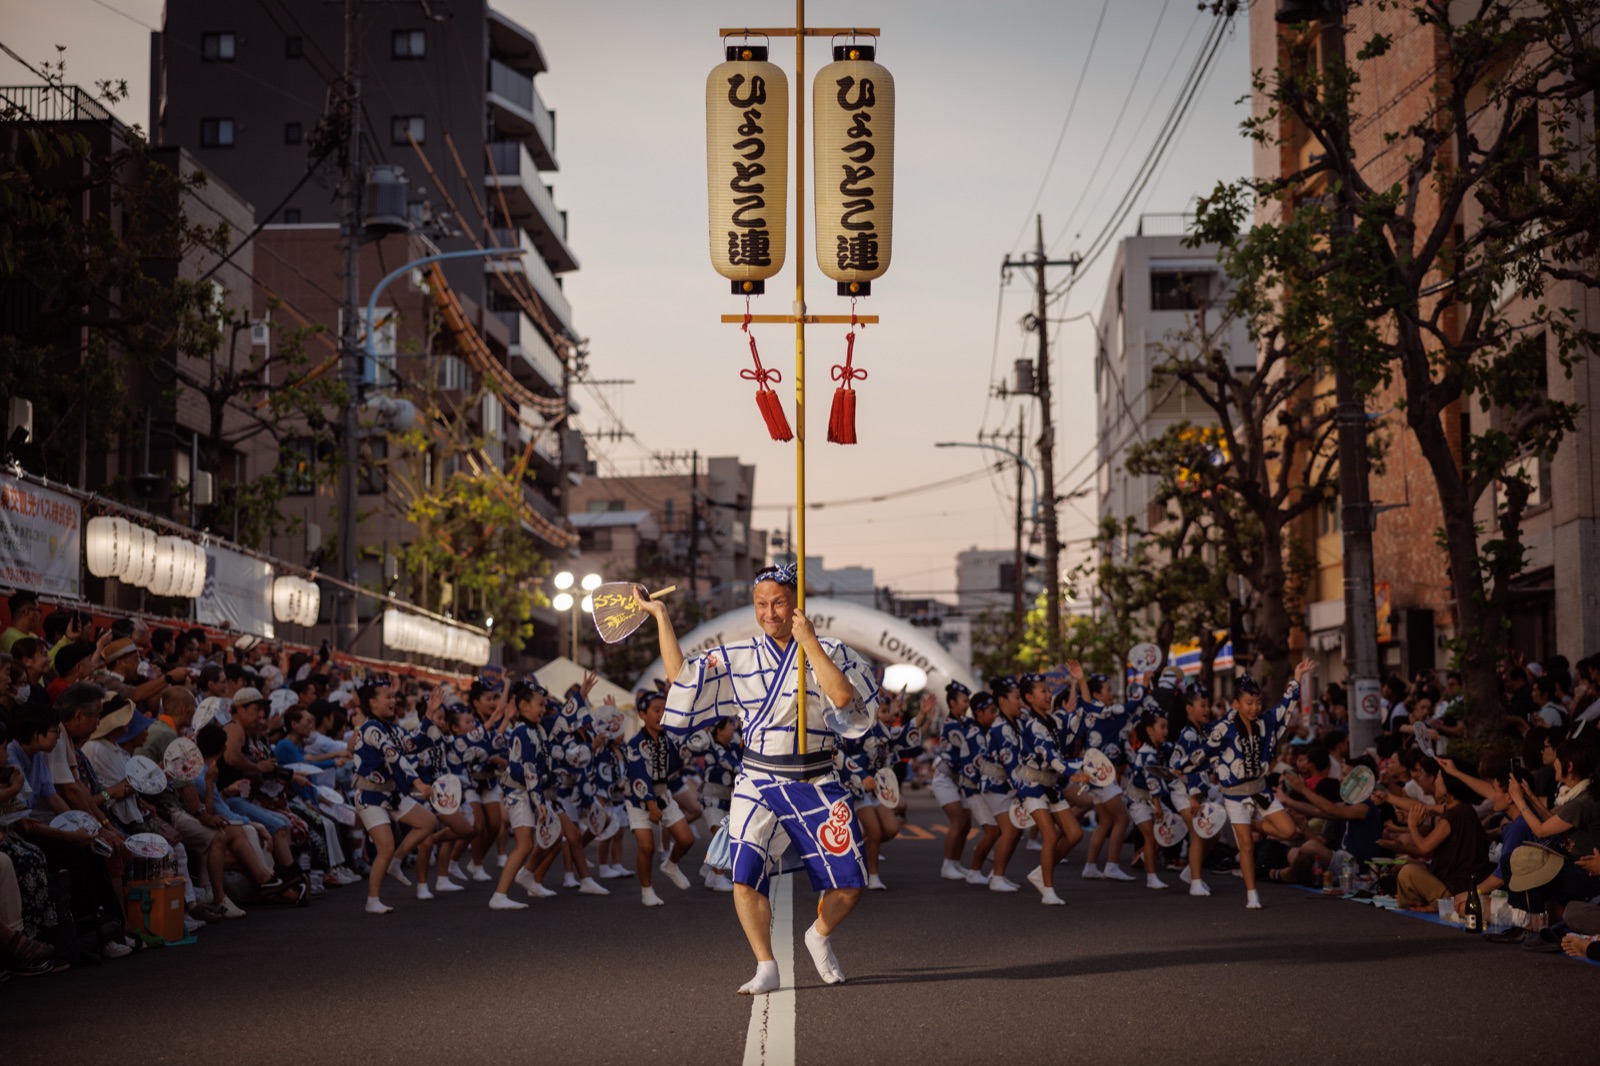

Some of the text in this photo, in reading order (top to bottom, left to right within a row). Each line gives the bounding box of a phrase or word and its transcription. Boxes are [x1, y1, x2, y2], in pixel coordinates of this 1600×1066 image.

[727, 73, 772, 268] ひょっとこ連
[836, 75, 880, 271] ひょっとこ連
[879, 630, 938, 677] tower
